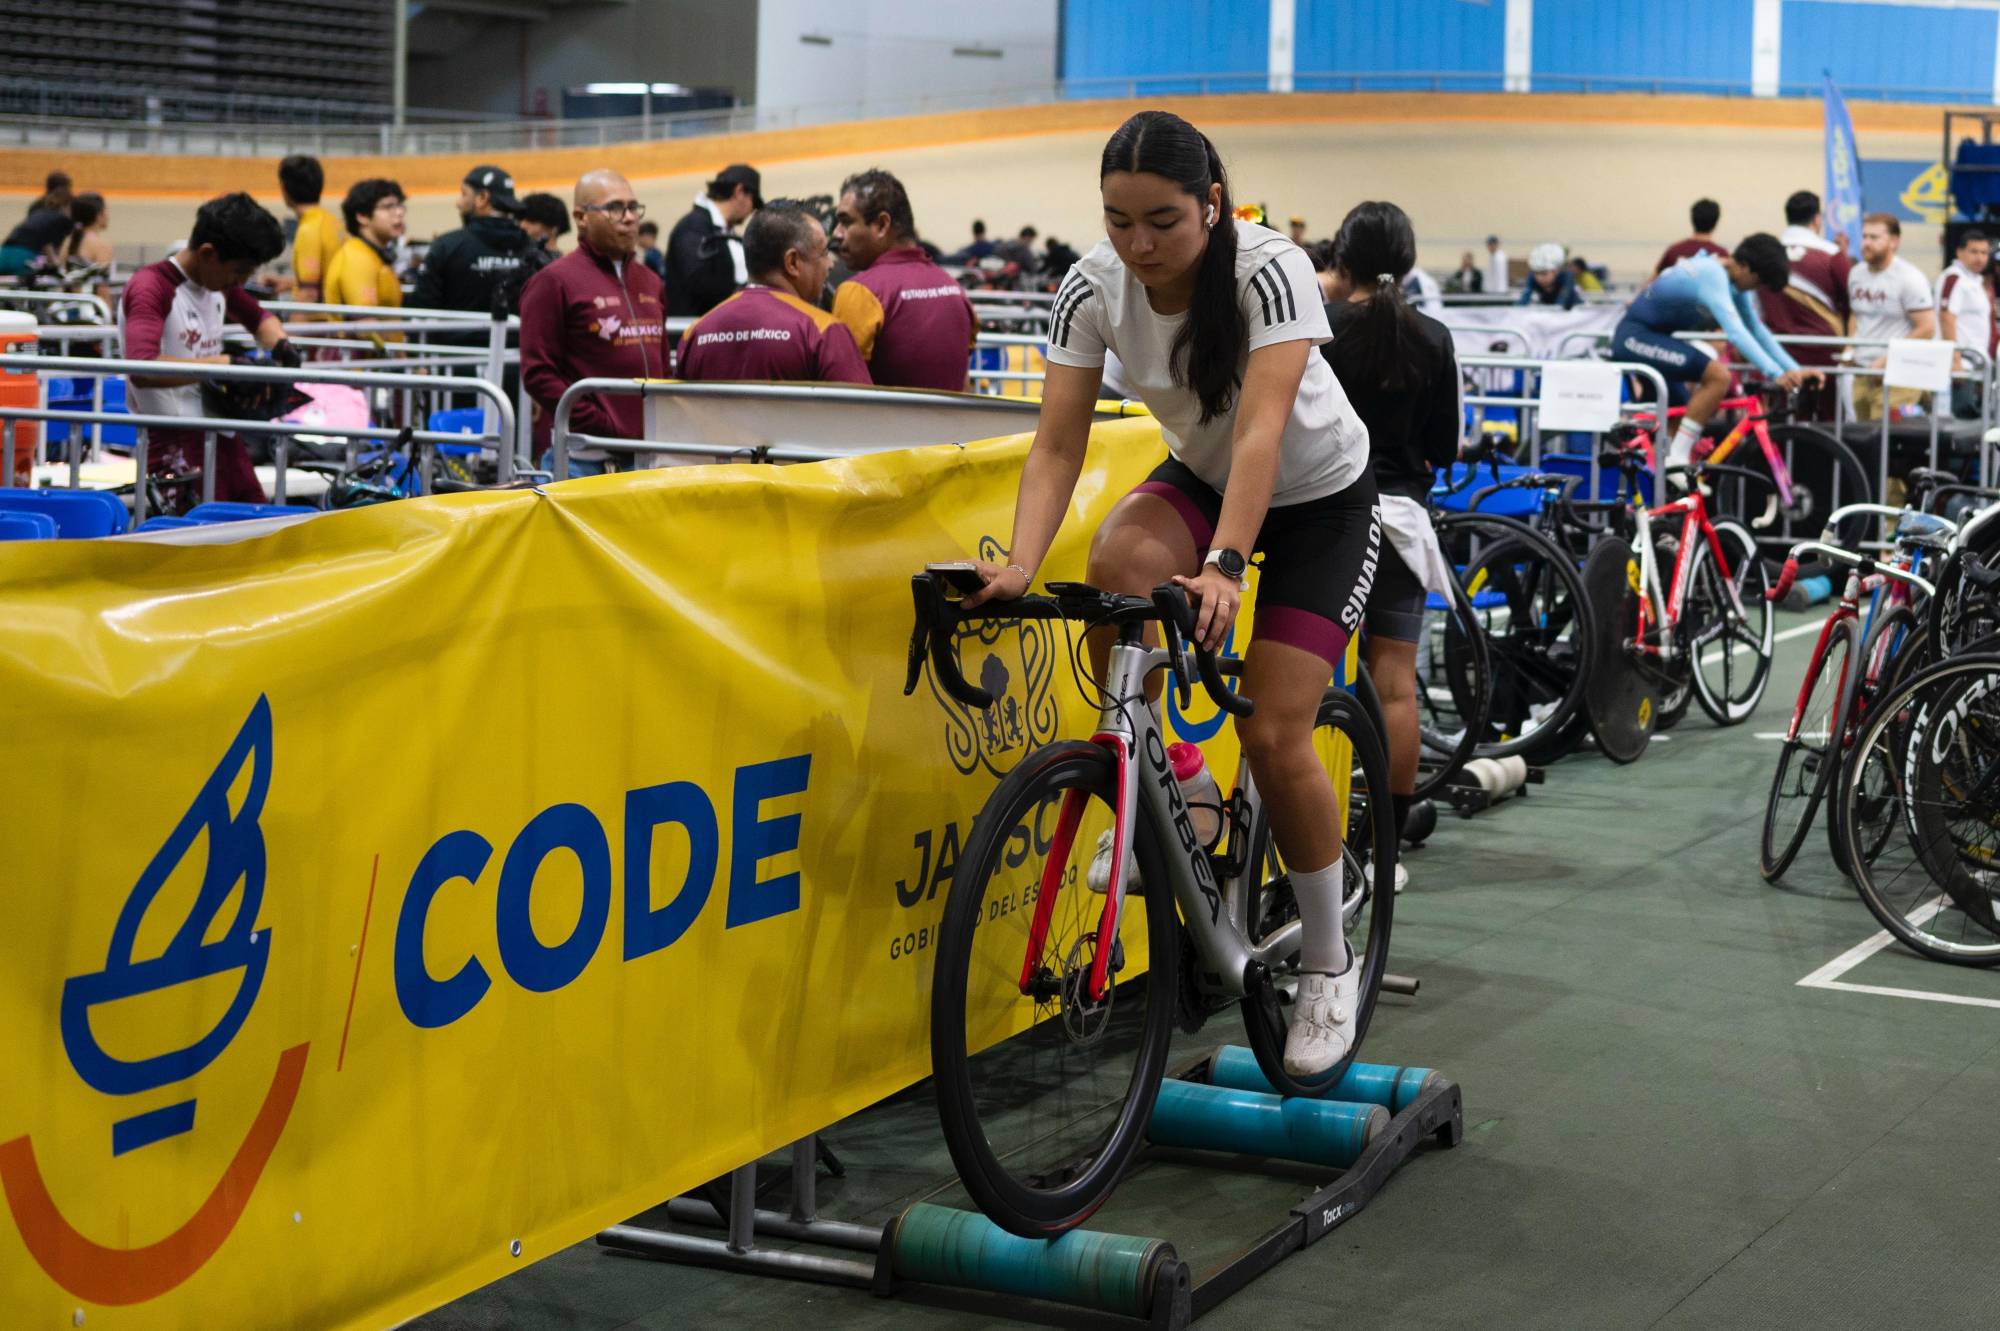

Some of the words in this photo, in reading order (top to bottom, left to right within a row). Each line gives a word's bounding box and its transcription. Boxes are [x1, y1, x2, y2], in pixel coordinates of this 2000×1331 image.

[697, 331, 734, 346] ESTADO
[736, 331, 750, 341] DE
[750, 328, 791, 341] MÉXICO
[1341, 504, 1382, 631] SINALOA
[1145, 727, 1222, 927] ORBEA
[394, 754, 812, 1029] CODE
[989, 891, 1016, 922] DEL
[1323, 1204, 1342, 1227] Tacx
